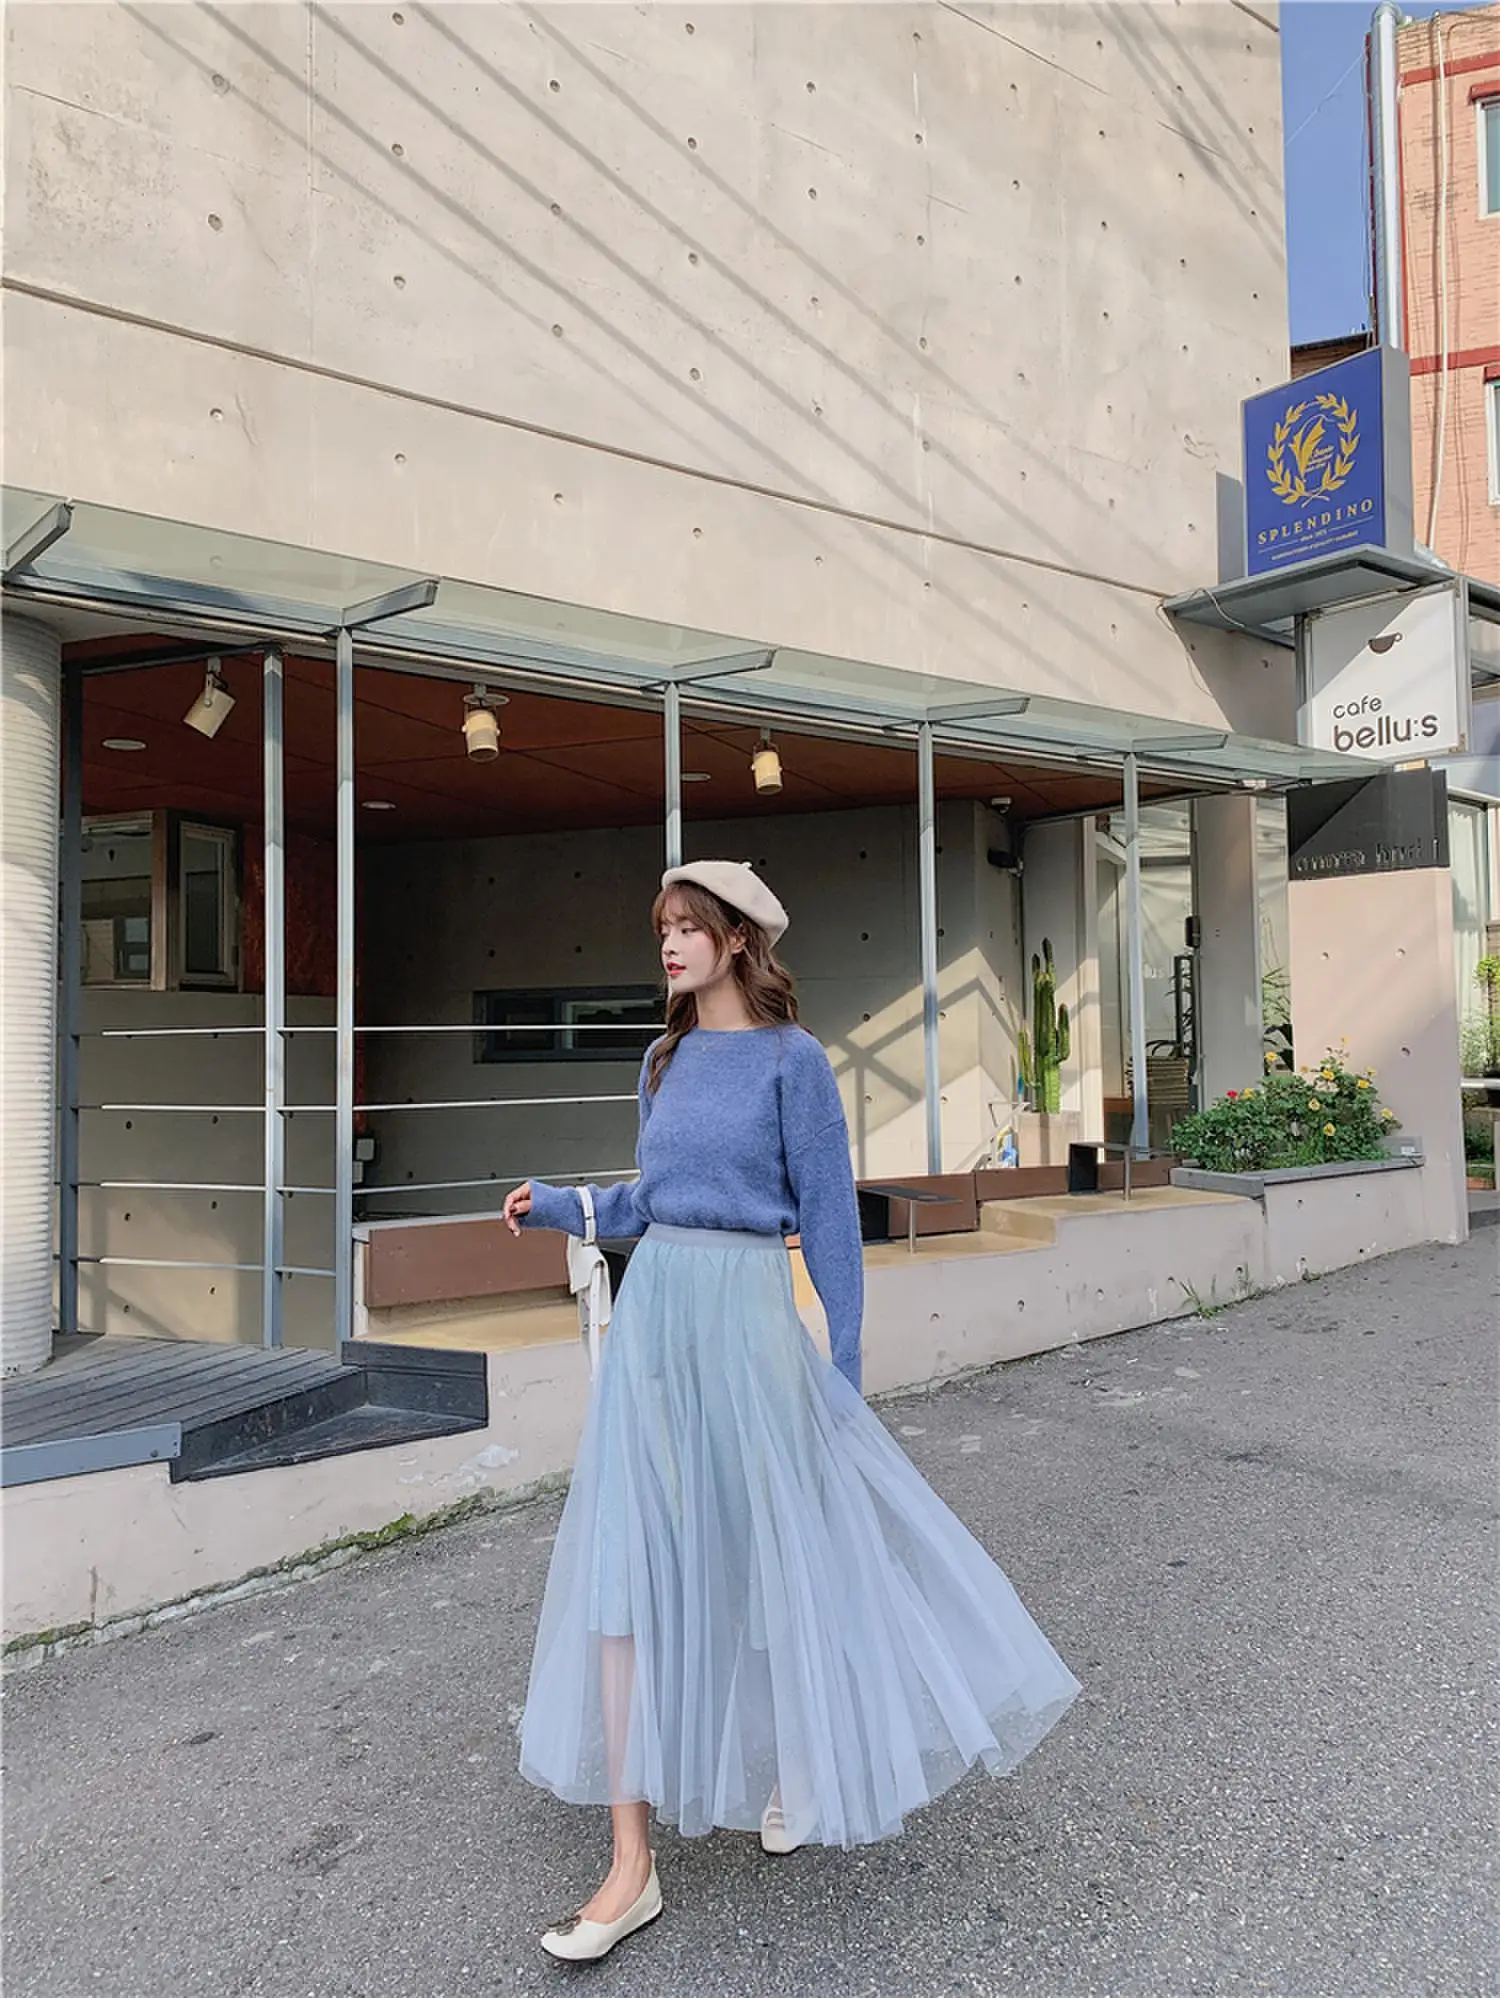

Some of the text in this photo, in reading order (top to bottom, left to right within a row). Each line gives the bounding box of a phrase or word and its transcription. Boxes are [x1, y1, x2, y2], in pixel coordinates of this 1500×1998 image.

[1257, 498, 1374, 546] SPLENDINO
[1333, 695, 1382, 719] cafe
[1334, 714, 1439, 753] bellu:s
